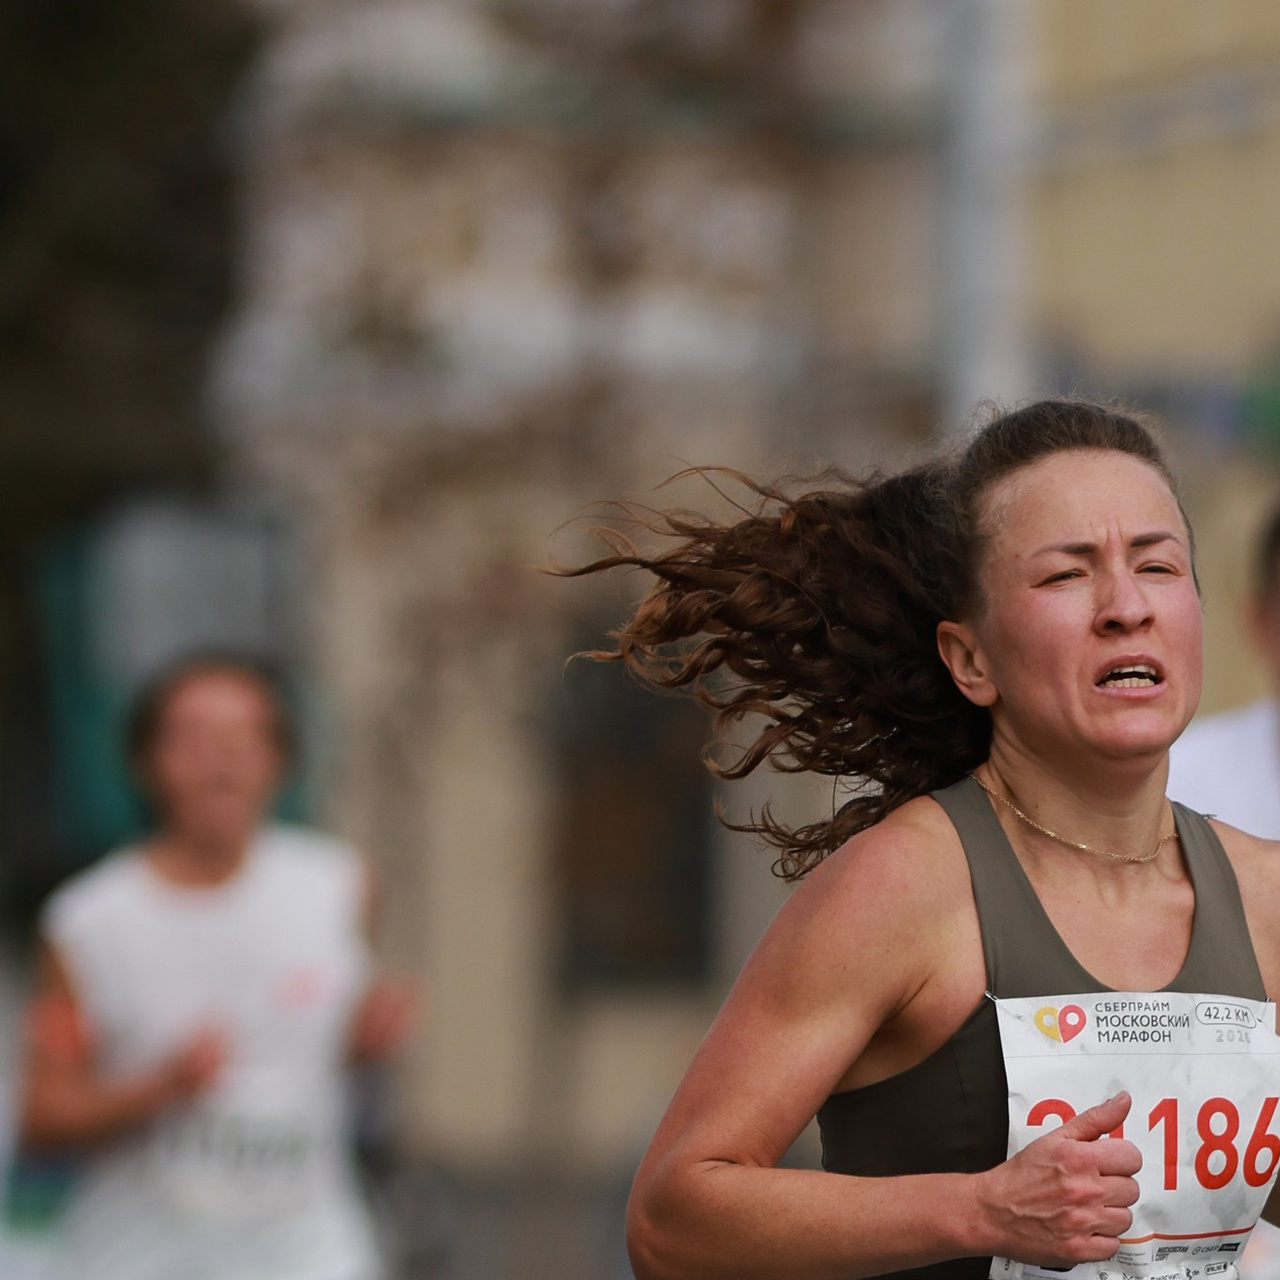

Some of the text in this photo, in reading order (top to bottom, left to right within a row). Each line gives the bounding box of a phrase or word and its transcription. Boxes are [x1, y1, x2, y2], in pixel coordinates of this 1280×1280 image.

[1095, 1000, 1170, 1012] СБЕРПРАЙМ
[1096, 1013, 1190, 1028] МОСКОВСКИЙ
[1204, 1006, 1231, 1021] 42,2
[1097, 1030, 1171, 1043] МАРАФОН
